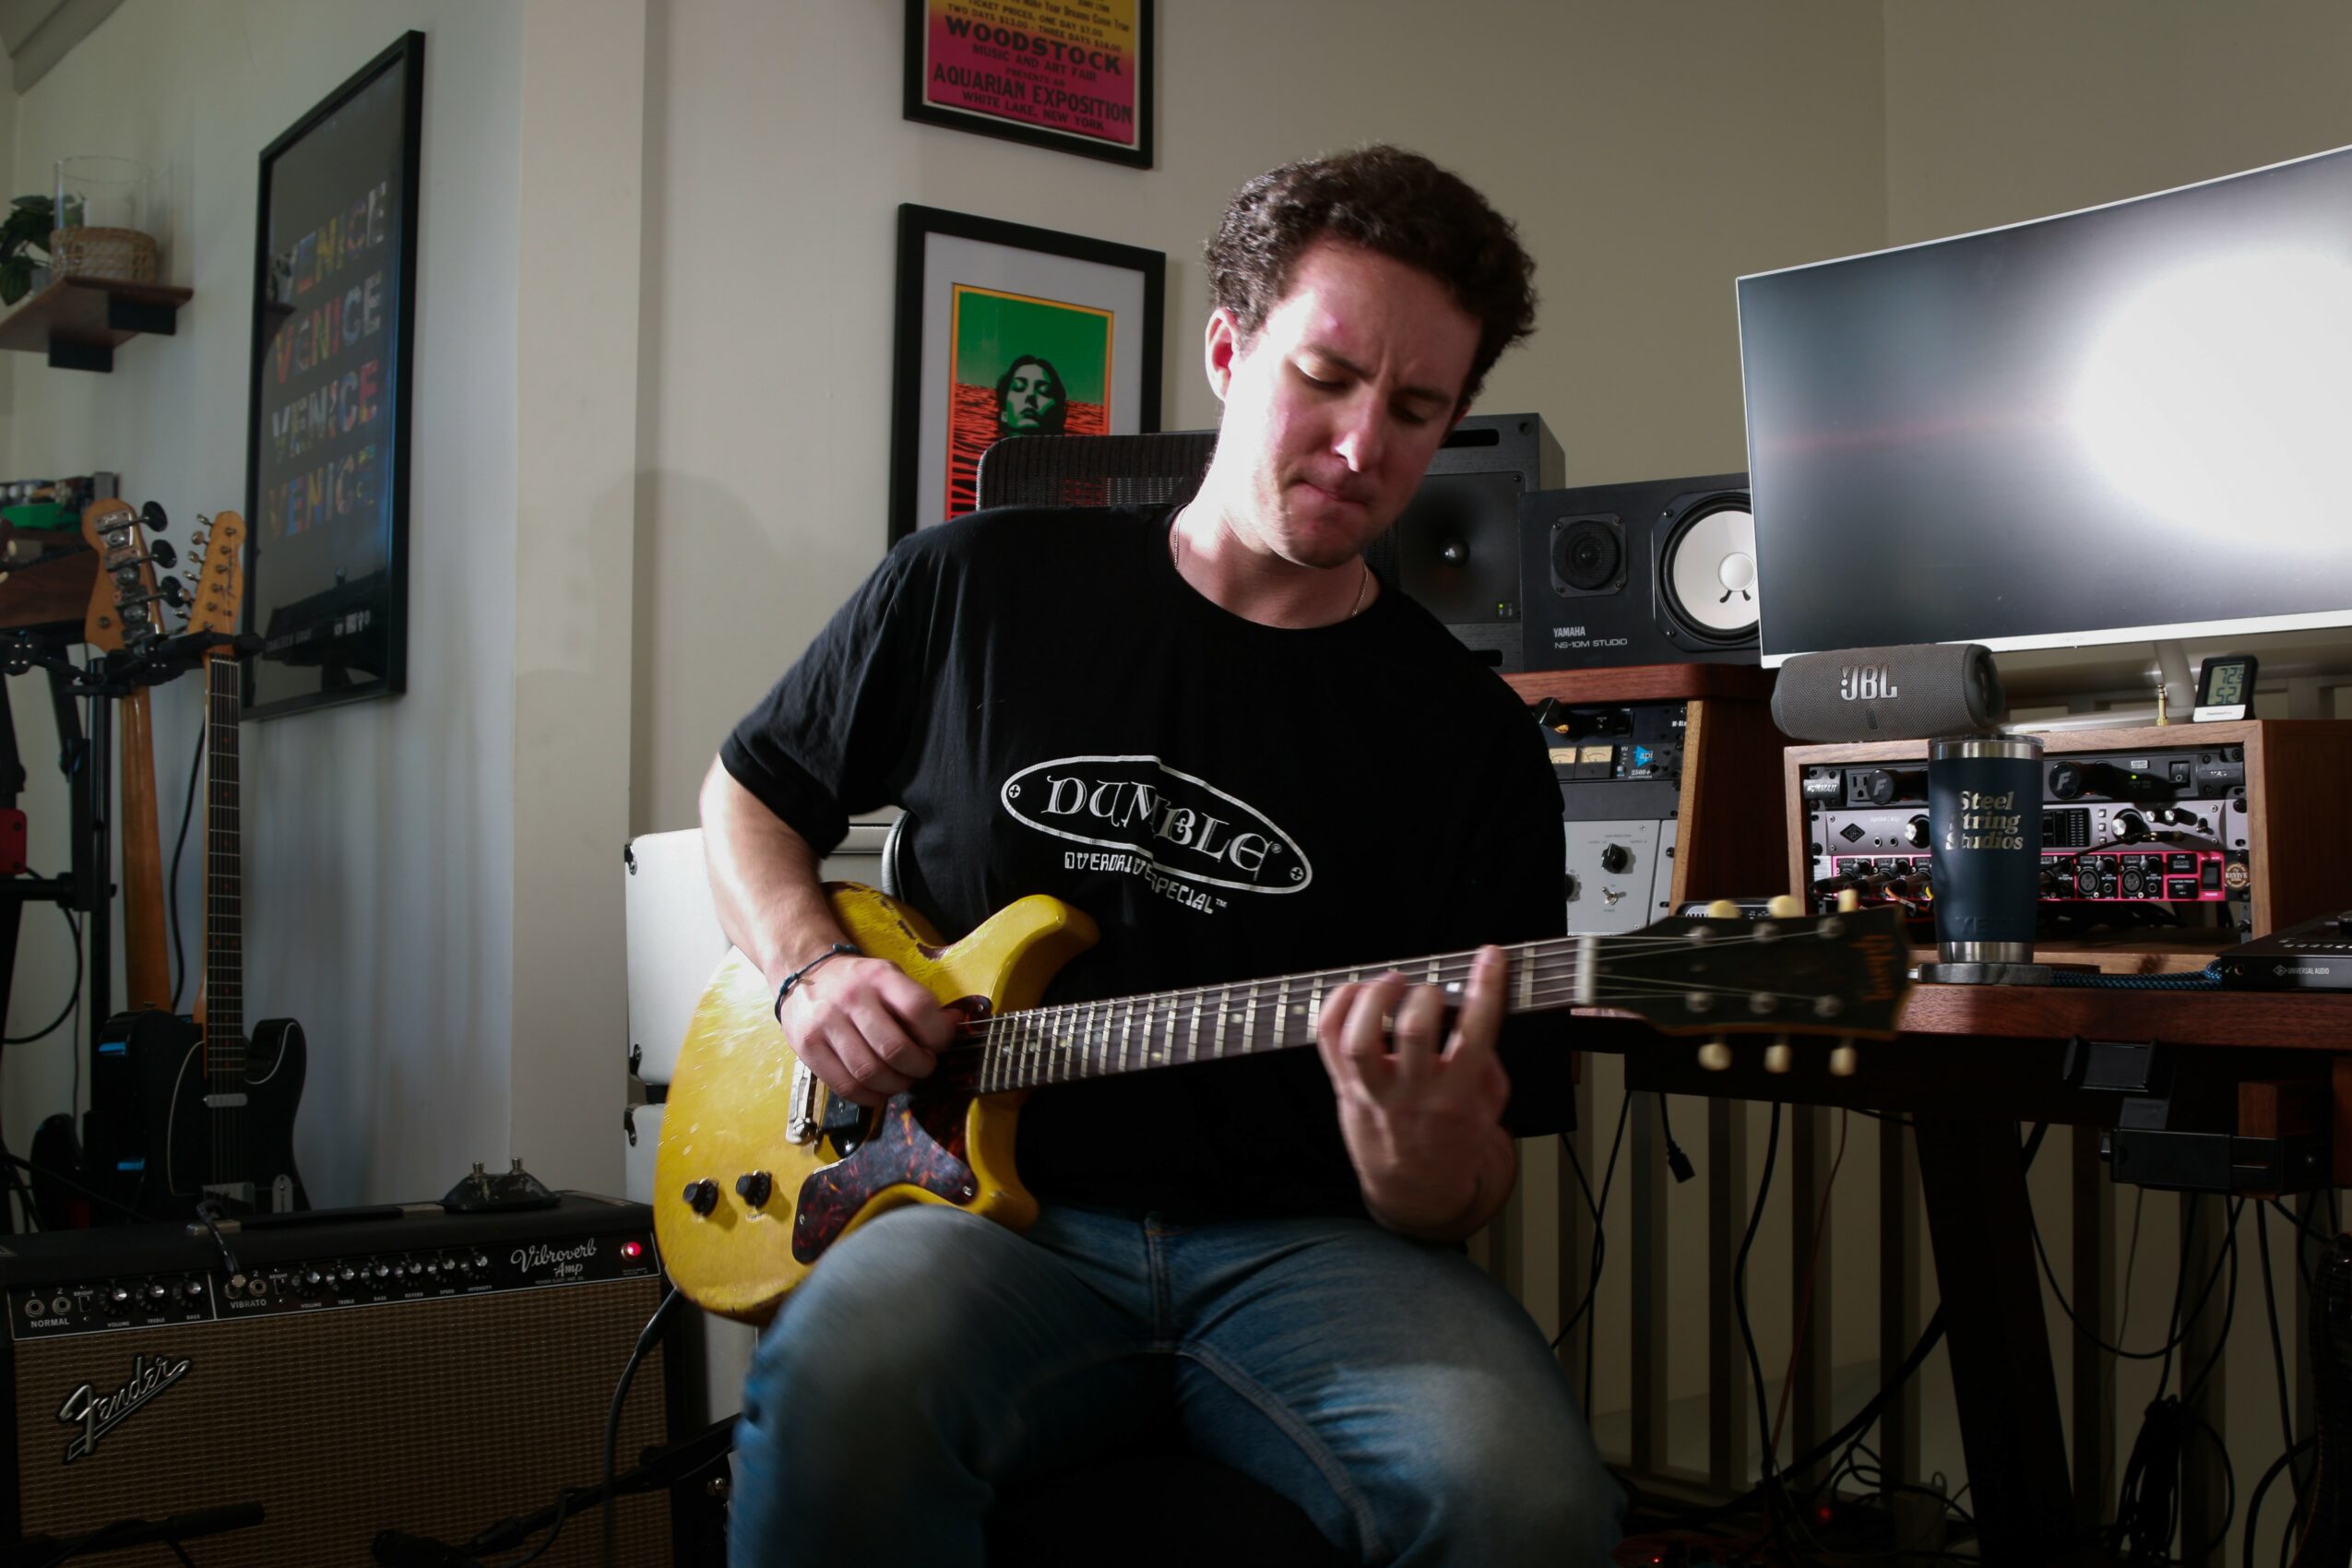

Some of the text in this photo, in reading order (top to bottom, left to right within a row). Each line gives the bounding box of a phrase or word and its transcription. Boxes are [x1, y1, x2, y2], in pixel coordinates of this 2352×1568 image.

[948, 3, 968, 15] TWO
[971, 8, 995, 21] DAYS
[1039, 25, 1064, 39] THREE
[1068, 32, 1090, 46] DAYS
[944, 15, 1122, 76] WOODSTOCK
[972, 44, 1098, 83] MUSIC AND ART FAIR
[1005, 66, 1065, 88] PRESENTS AN
[933, 62, 1134, 125] AQUARIAN EXPOSITION
[962, 90, 1001, 110] WHITE
[1042, 107, 1069, 124] NEW
[1075, 114, 1105, 131] YORK
[276, 271, 383, 385] VENICE
[271, 358, 379, 464] VENICE
[268, 443, 377, 542] VENICE
[1552, 626, 1586, 638] YAMAHA
[1554, 638, 1628, 649] NS-10M STUDIO
[1840, 663, 1898, 701] JBL
[2215, 686, 2238, 705] 52
[1638, 751, 1654, 763] api
[1960, 790, 2014, 811] Steel
[2287, 966, 2330, 975] UNIVERSAL AUDIO
[510, 1240, 598, 1275] Vibroverb
[252, 1269, 260, 1277] 2
[553, 1263, 584, 1277] Amp
[230, 1299, 267, 1310] VIBRATO
[30, 1317, 71, 1328] NORMAL
[147, 1316, 165, 1324] TREBLE
[186, 1313, 201, 1321] BASS
[58, 1355, 191, 1455] Fender
